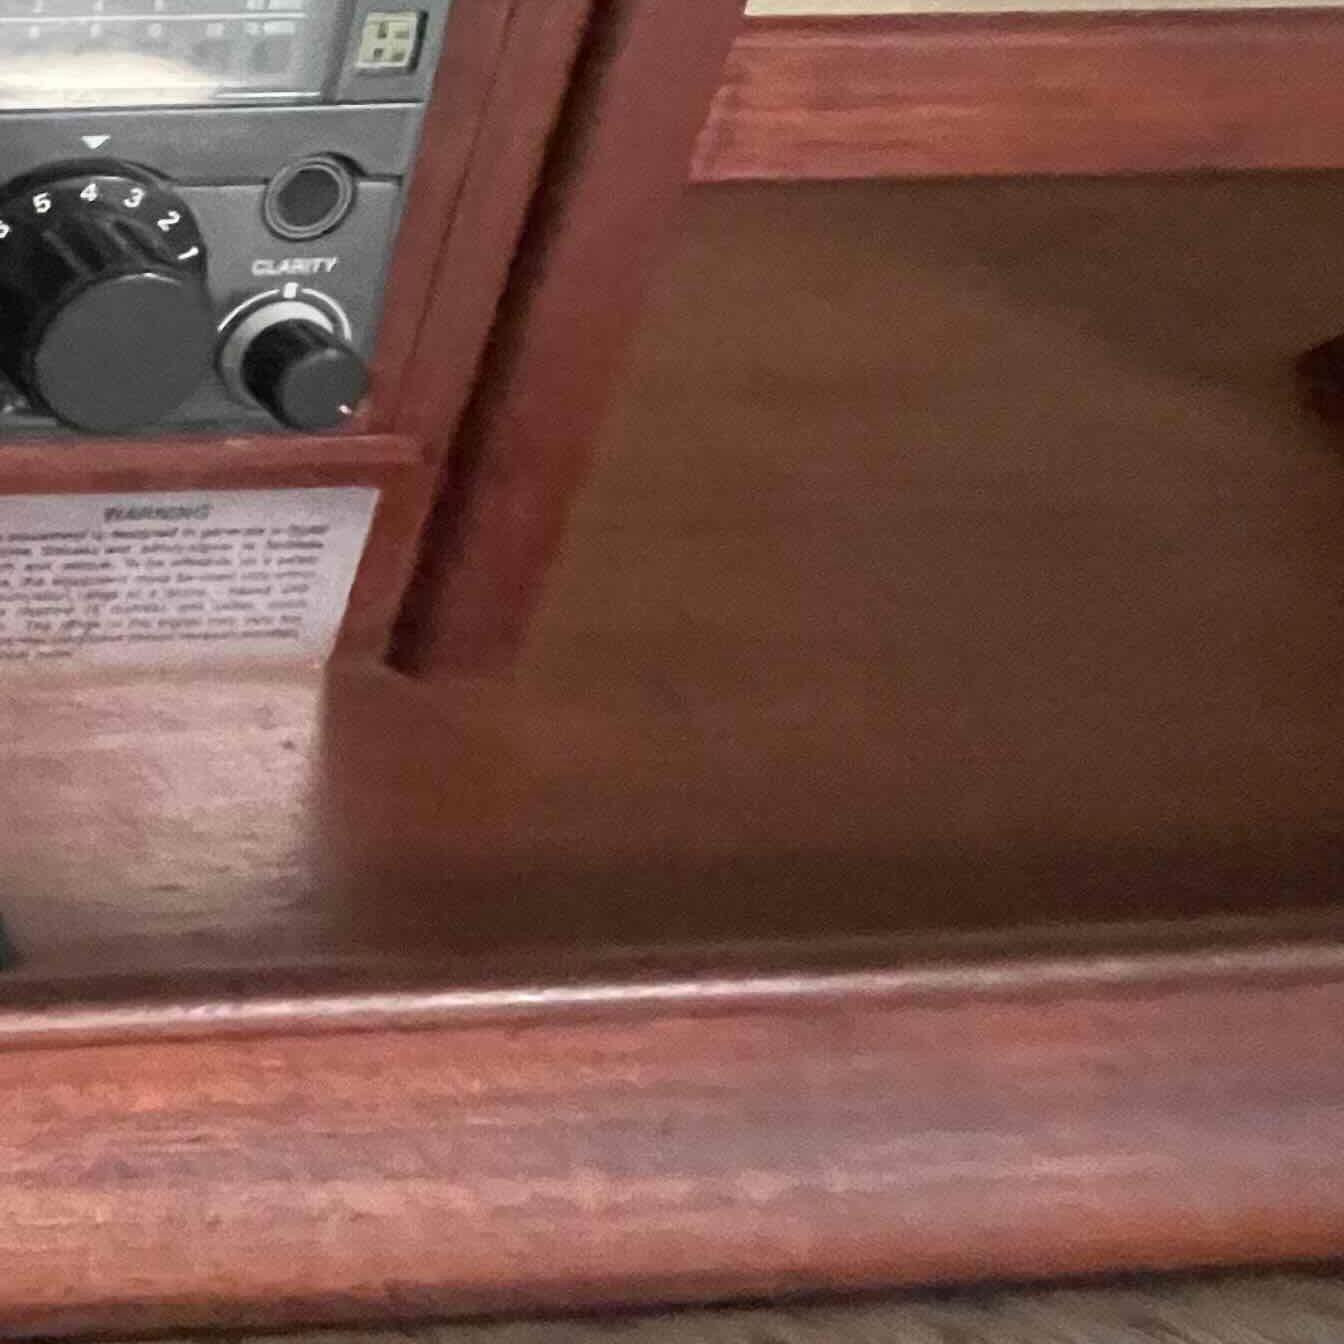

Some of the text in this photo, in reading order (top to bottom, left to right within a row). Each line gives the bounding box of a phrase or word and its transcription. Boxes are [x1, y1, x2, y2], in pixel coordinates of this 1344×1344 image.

[80, 183, 98, 202] 4
[124, 187, 144, 208] 3
[32, 193, 51, 213] 5
[157, 210, 181, 232] 2
[178, 246, 200, 261] 1
[252, 256, 339, 276] CLARITY
